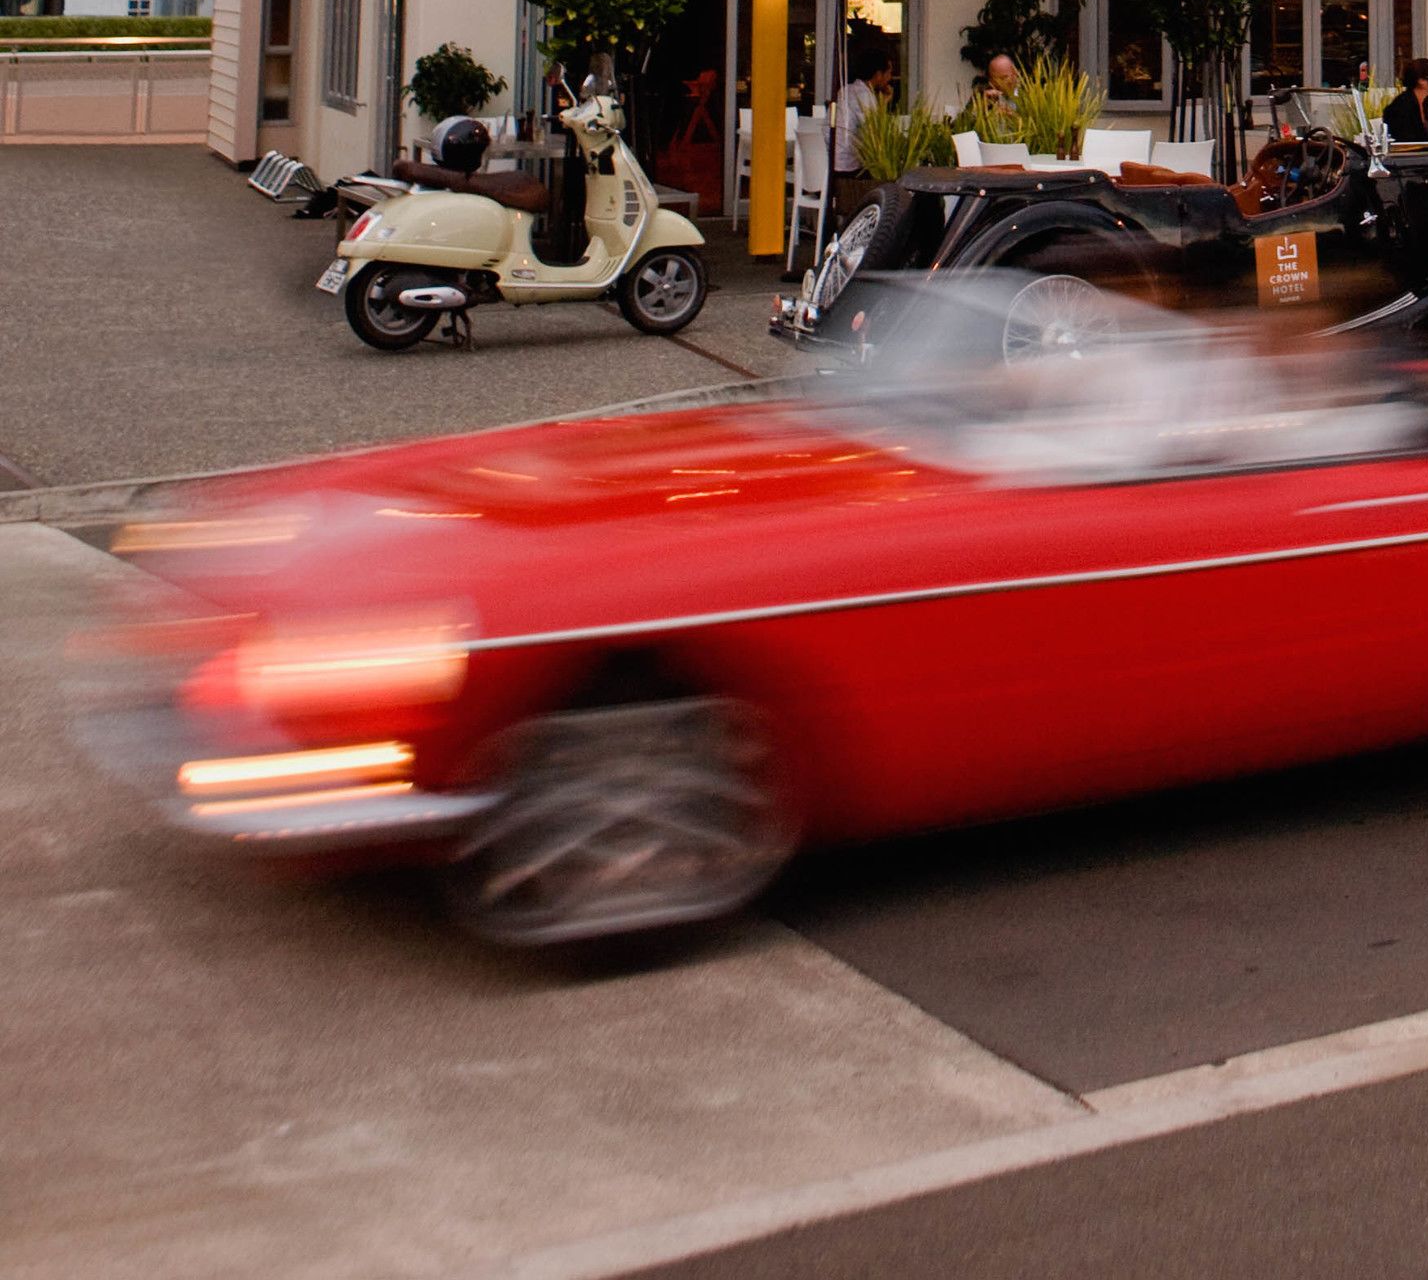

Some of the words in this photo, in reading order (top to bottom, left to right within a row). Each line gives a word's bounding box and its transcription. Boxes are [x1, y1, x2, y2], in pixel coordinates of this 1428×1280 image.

[1277, 261, 1298, 272] THE
[1269, 271, 1309, 284] CROWN
[1272, 283, 1305, 295] HOTEL
